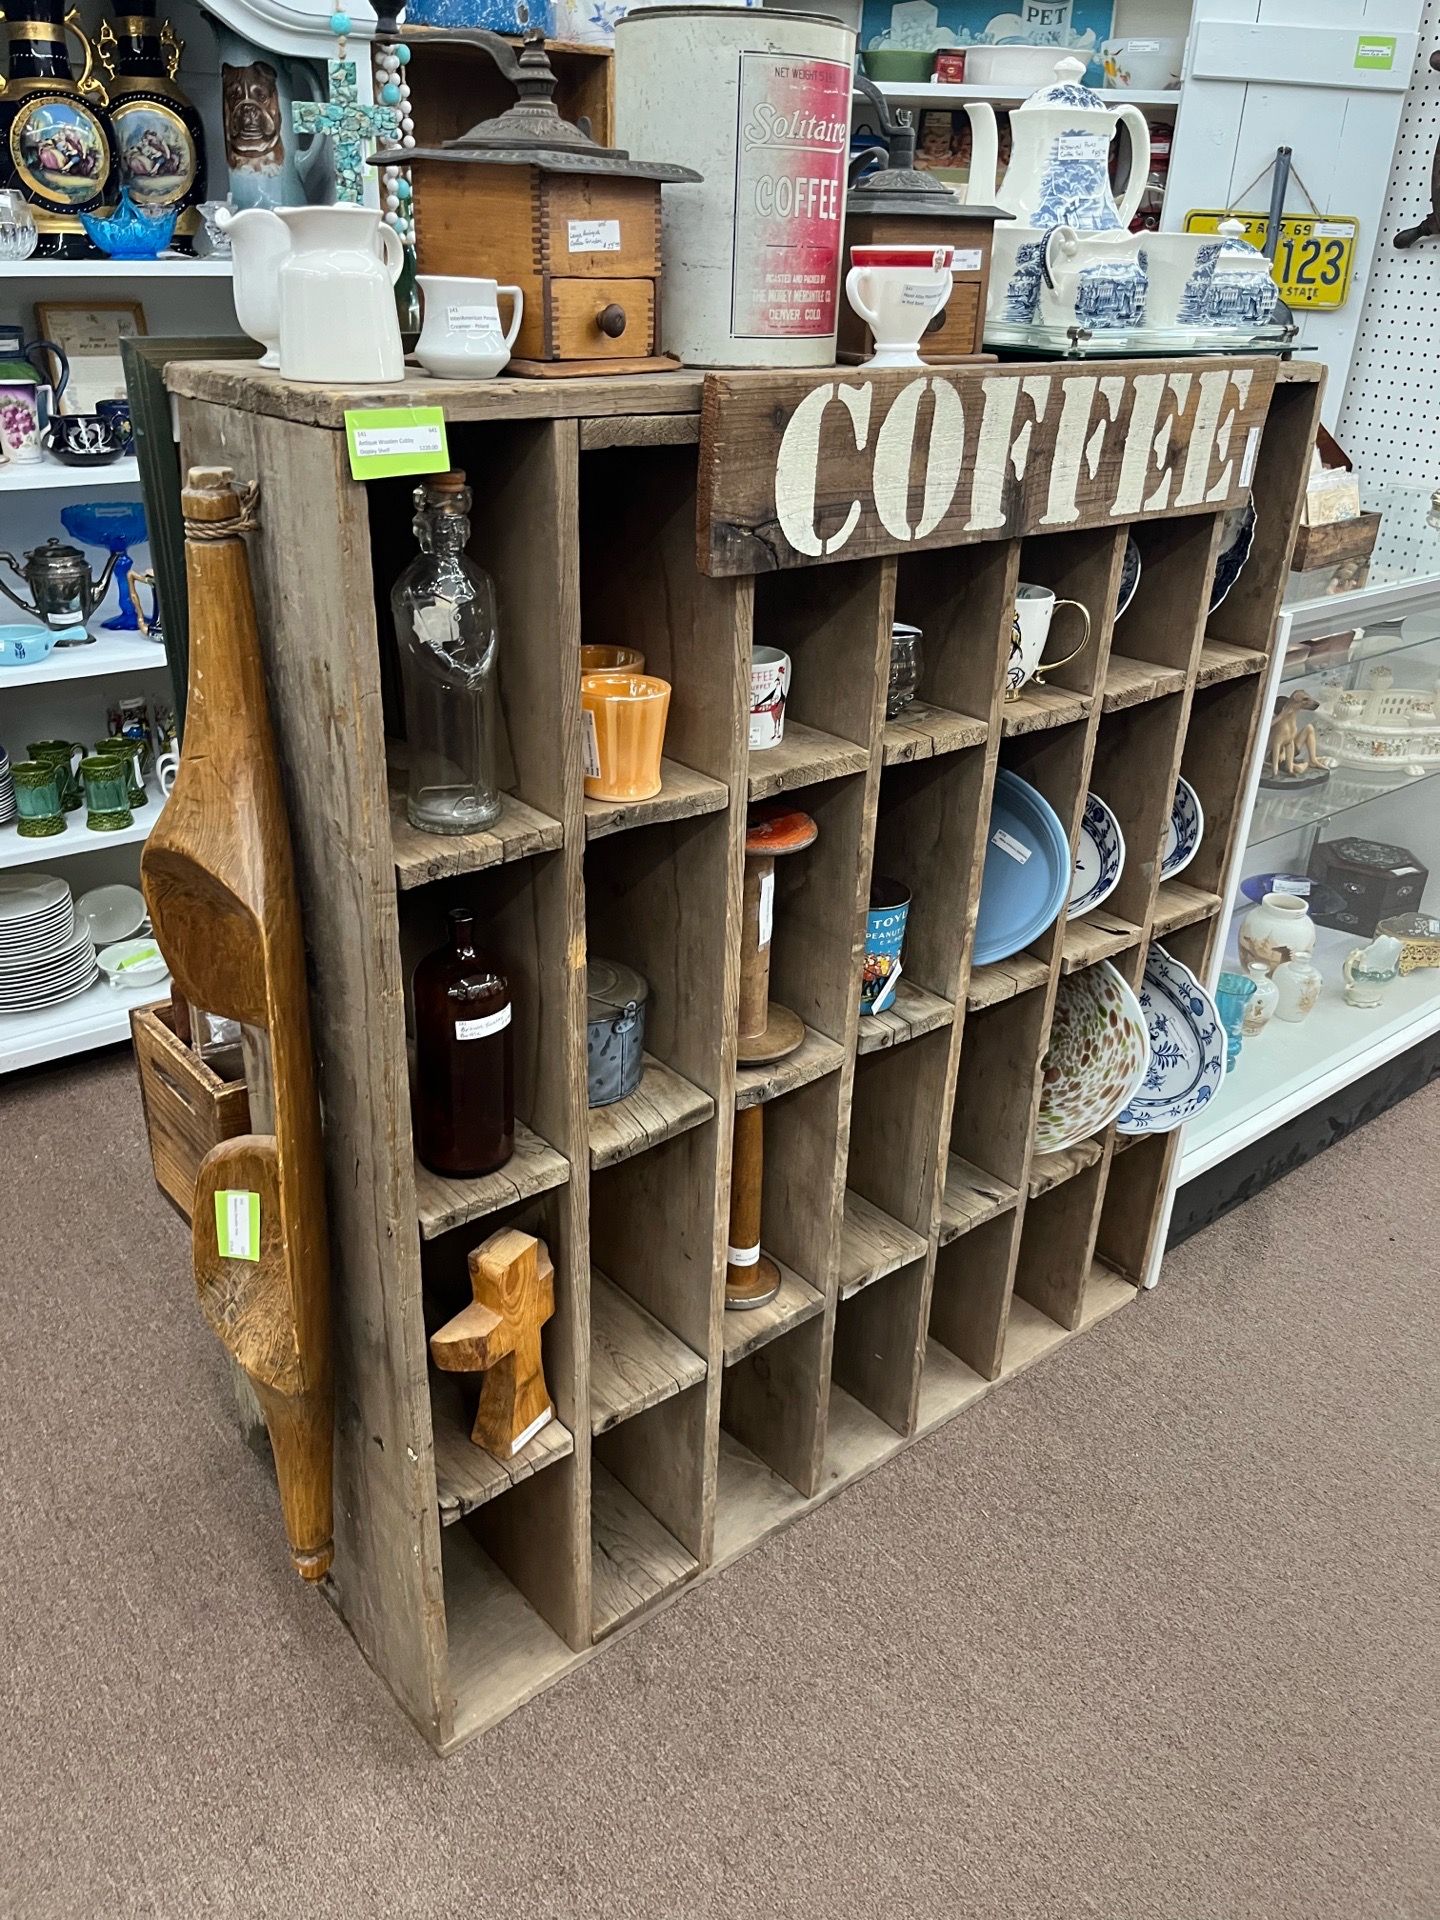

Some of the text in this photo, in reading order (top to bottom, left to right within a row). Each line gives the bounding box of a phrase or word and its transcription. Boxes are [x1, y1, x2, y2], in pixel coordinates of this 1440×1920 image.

[1026, 6, 1068, 26] PET
[774, 67, 790, 78] NET
[791, 68, 818, 81] WEIGHT
[744, 101, 846, 146] Solitaire
[754, 174, 840, 221] COFFEE
[1293, 224, 1312, 236] 69
[1282, 238, 1345, 286] 123
[1285, 286, 1320, 298] STATE
[774, 368, 1254, 558] COFFEE
[751, 669, 774, 682] FFEE
[872, 909, 908, 930] TOYL
[865, 928, 901, 940] PEANUT
